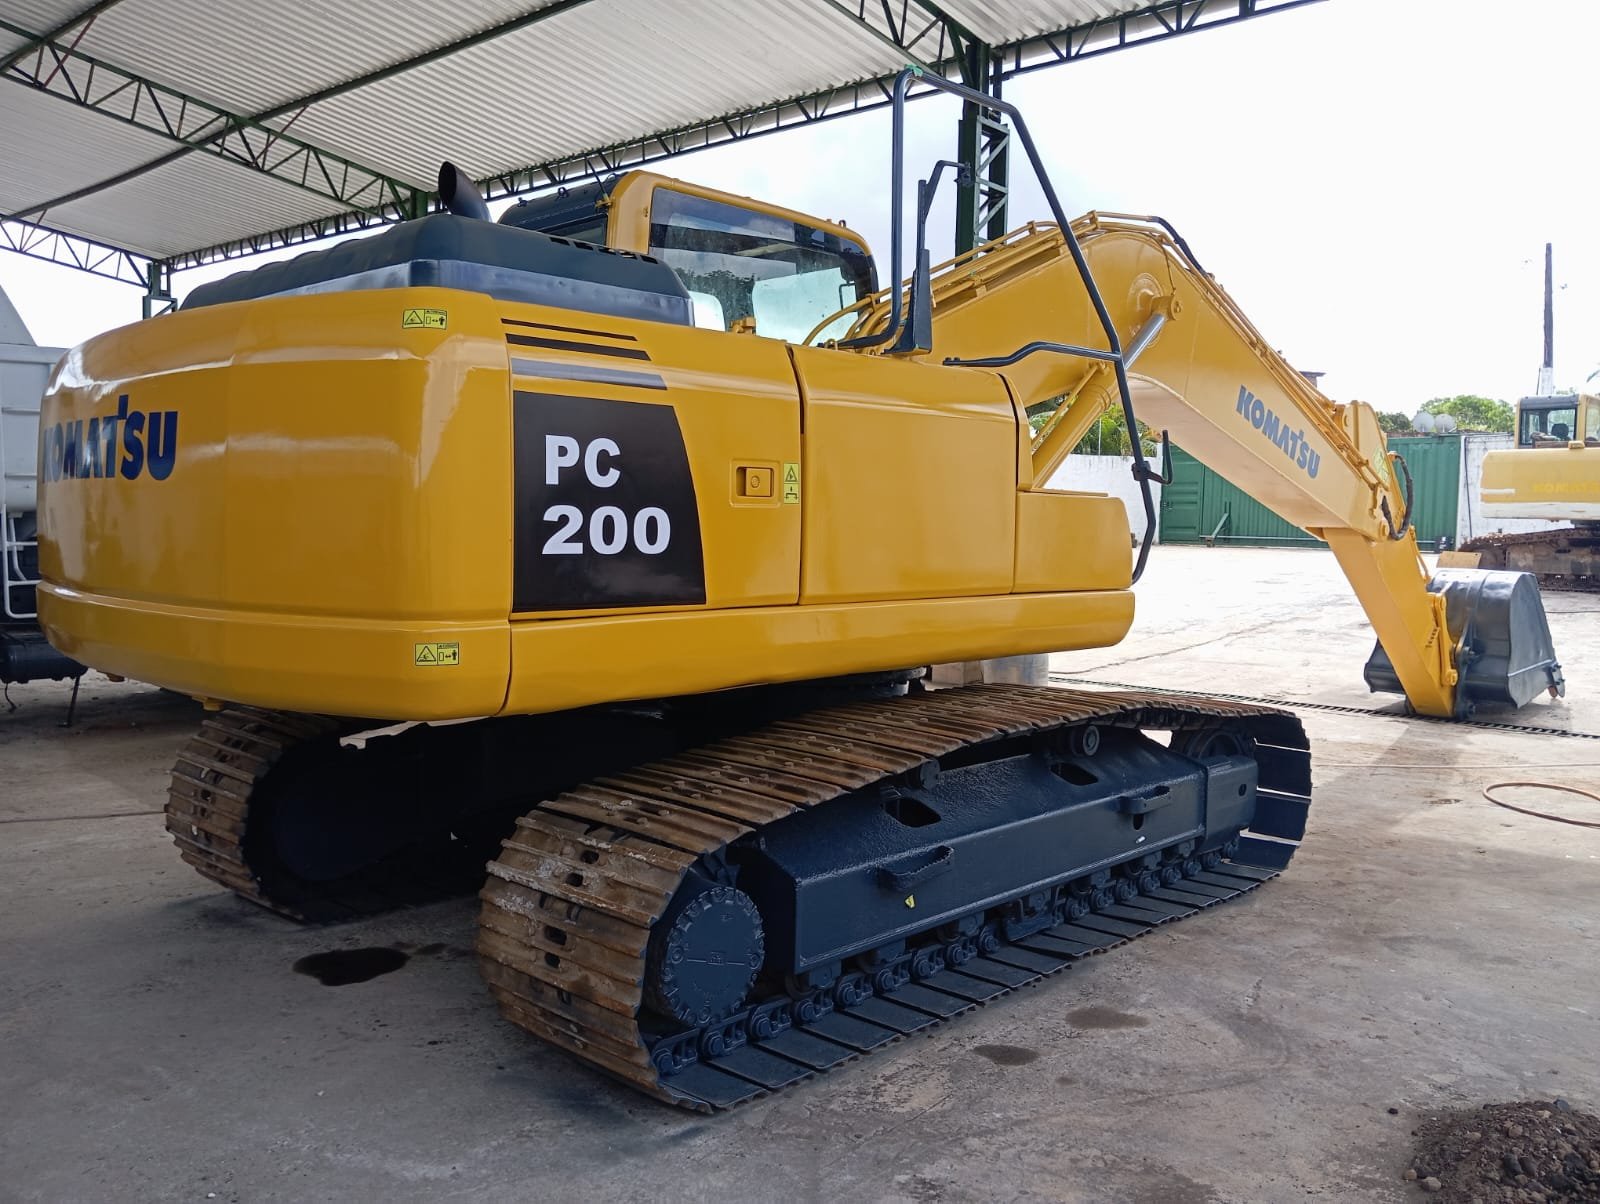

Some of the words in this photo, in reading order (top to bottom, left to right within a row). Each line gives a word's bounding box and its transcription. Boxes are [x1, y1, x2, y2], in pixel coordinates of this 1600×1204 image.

[1236, 384, 1320, 479] KOMATSU
[545, 435, 621, 488] PC
[542, 504, 671, 555] 200
